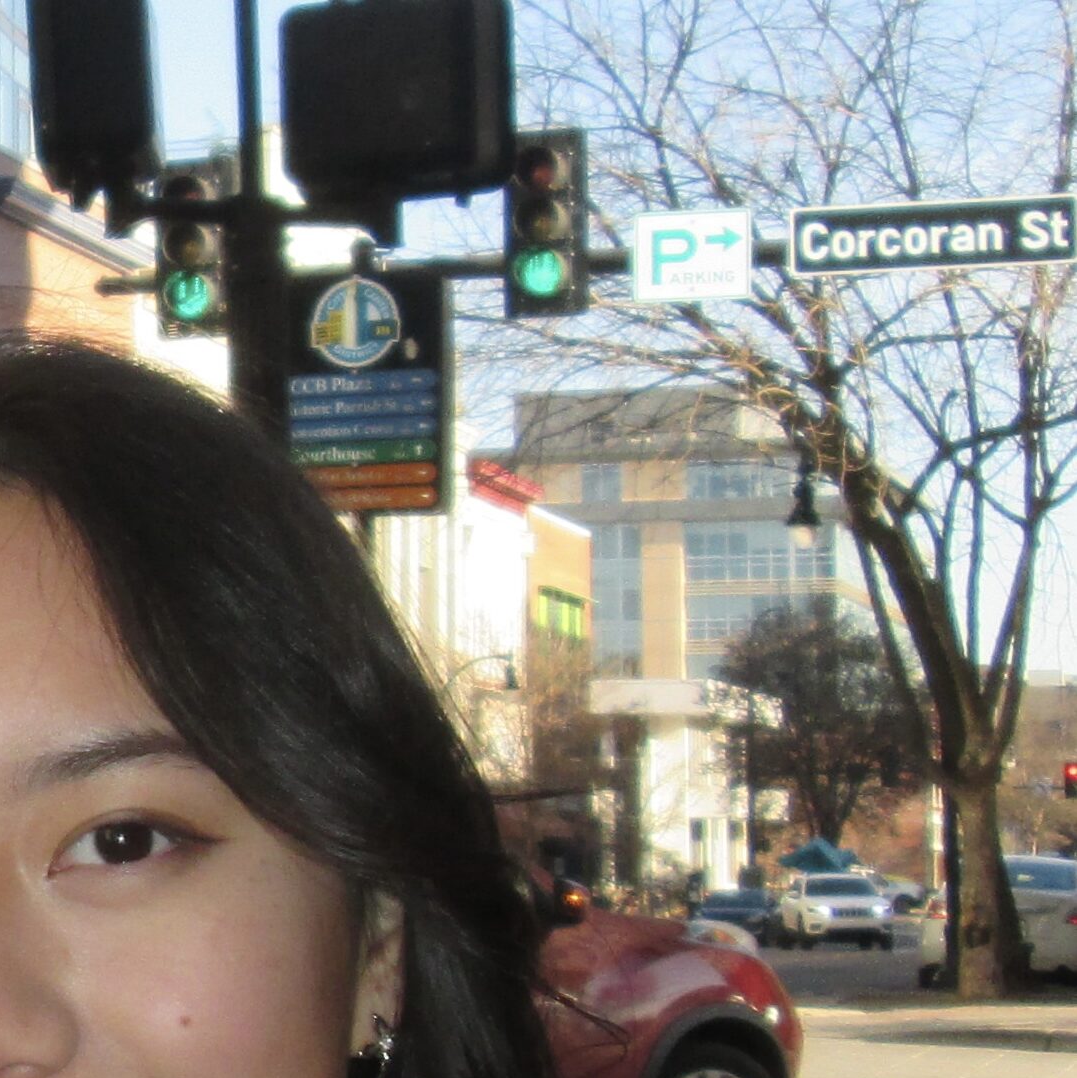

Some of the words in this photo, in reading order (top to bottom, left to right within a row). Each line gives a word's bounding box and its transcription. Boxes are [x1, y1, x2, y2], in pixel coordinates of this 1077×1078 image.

[800, 221, 1005, 261] Corcoran
[1019, 209, 1070, 250] St
[291, 377, 327, 394] CCB
